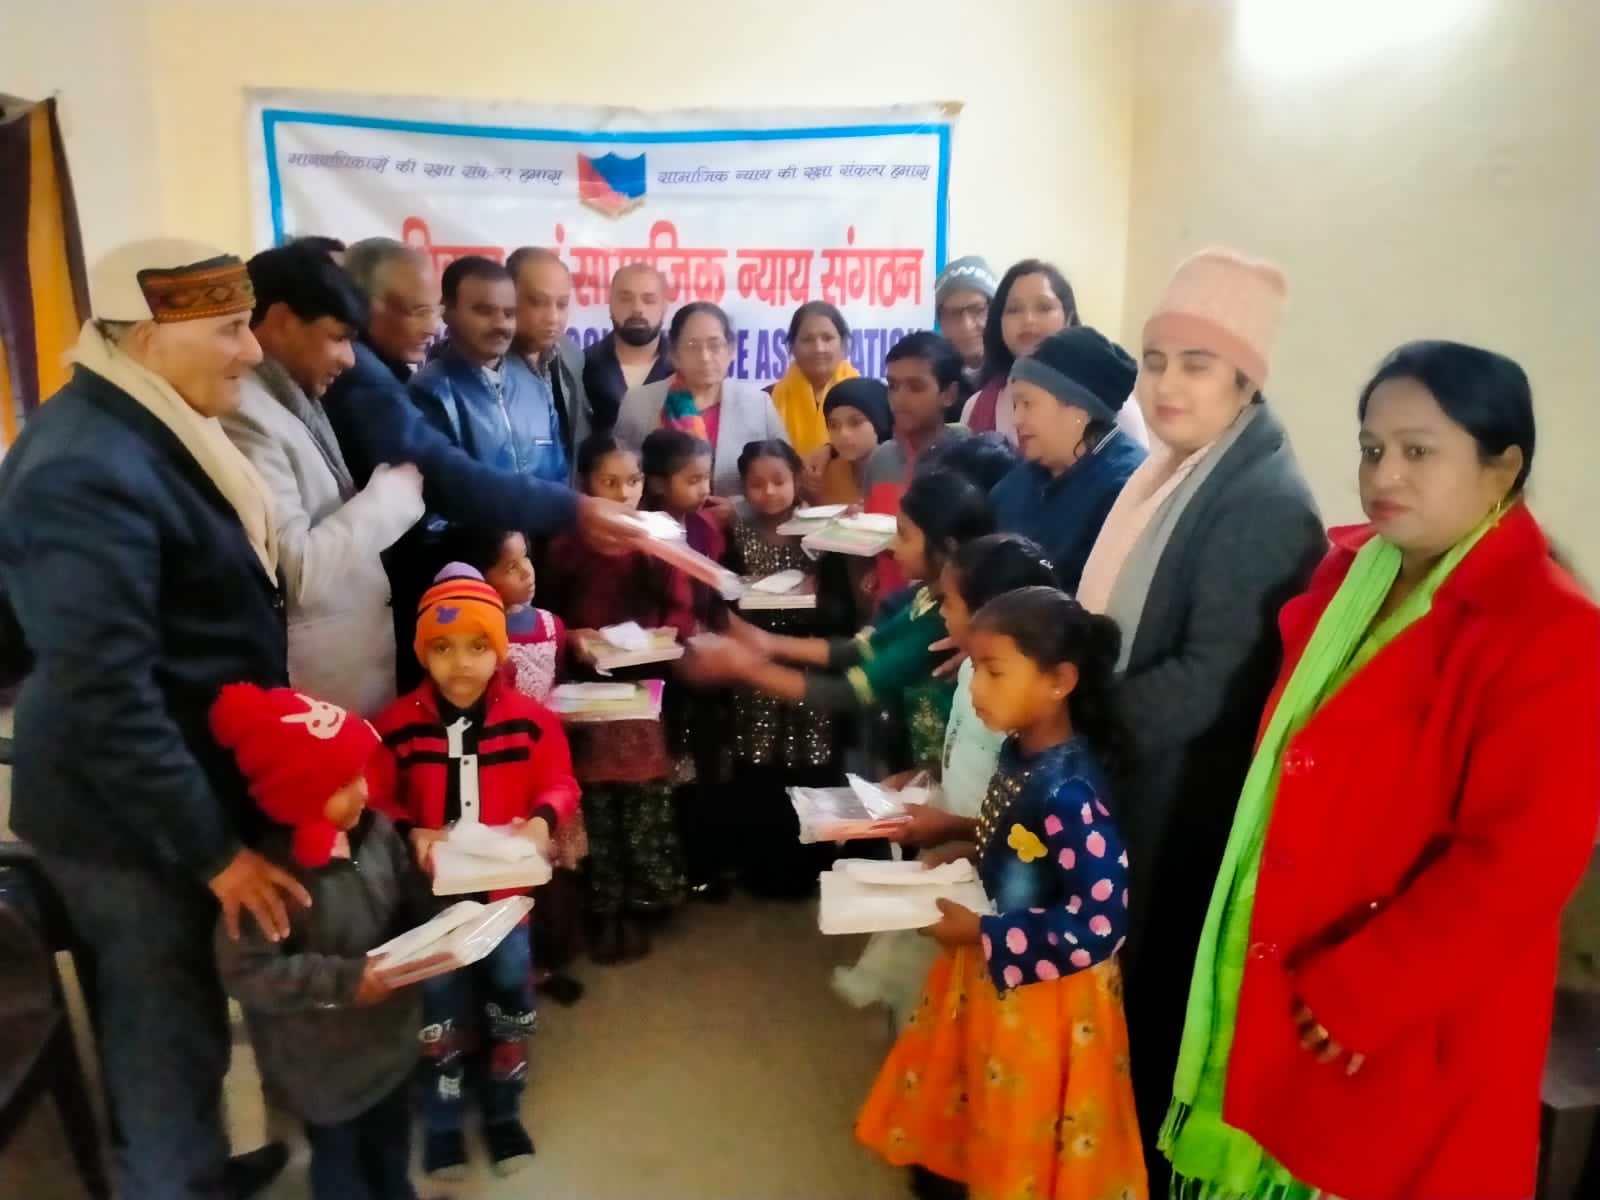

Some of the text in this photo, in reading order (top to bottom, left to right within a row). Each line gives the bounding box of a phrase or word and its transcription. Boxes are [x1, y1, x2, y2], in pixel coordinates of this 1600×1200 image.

[395, 157, 417, 174] की
[423, 163, 456, 179] रक्षा
[657, 165, 731, 184] सामाजिक
[735, 168, 772, 182] न्याय
[777, 164, 799, 180] की
[803, 165, 833, 181] रक्षा
[839, 160, 887, 178] संकल्प
[736, 248, 814, 307] न्याय
[820, 225, 925, 307] संगठन
